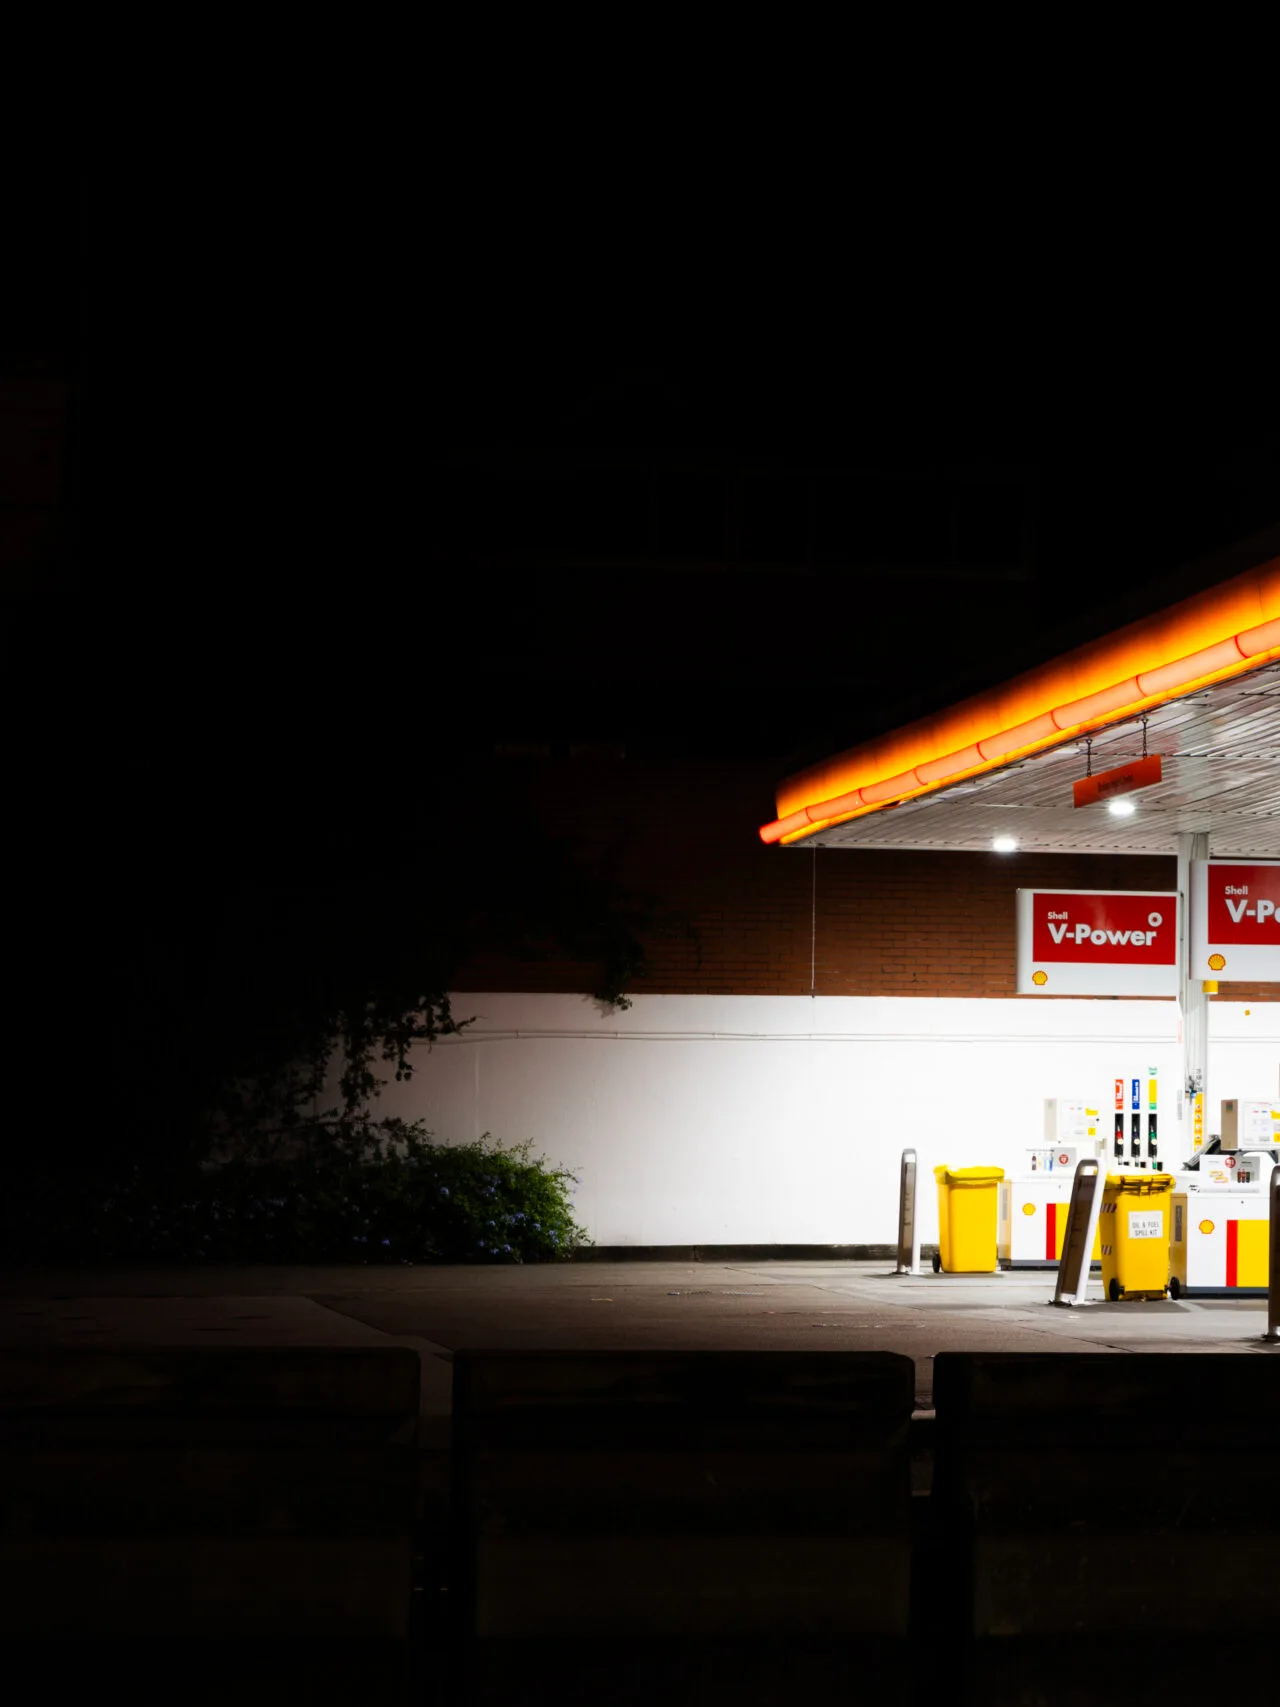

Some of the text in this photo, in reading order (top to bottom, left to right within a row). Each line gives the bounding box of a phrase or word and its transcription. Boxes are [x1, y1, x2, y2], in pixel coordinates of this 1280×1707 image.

[1225, 885, 1249, 895] Shell
[1047, 911, 1068, 920] Shell
[1047, 923, 1157, 946] V-Power
